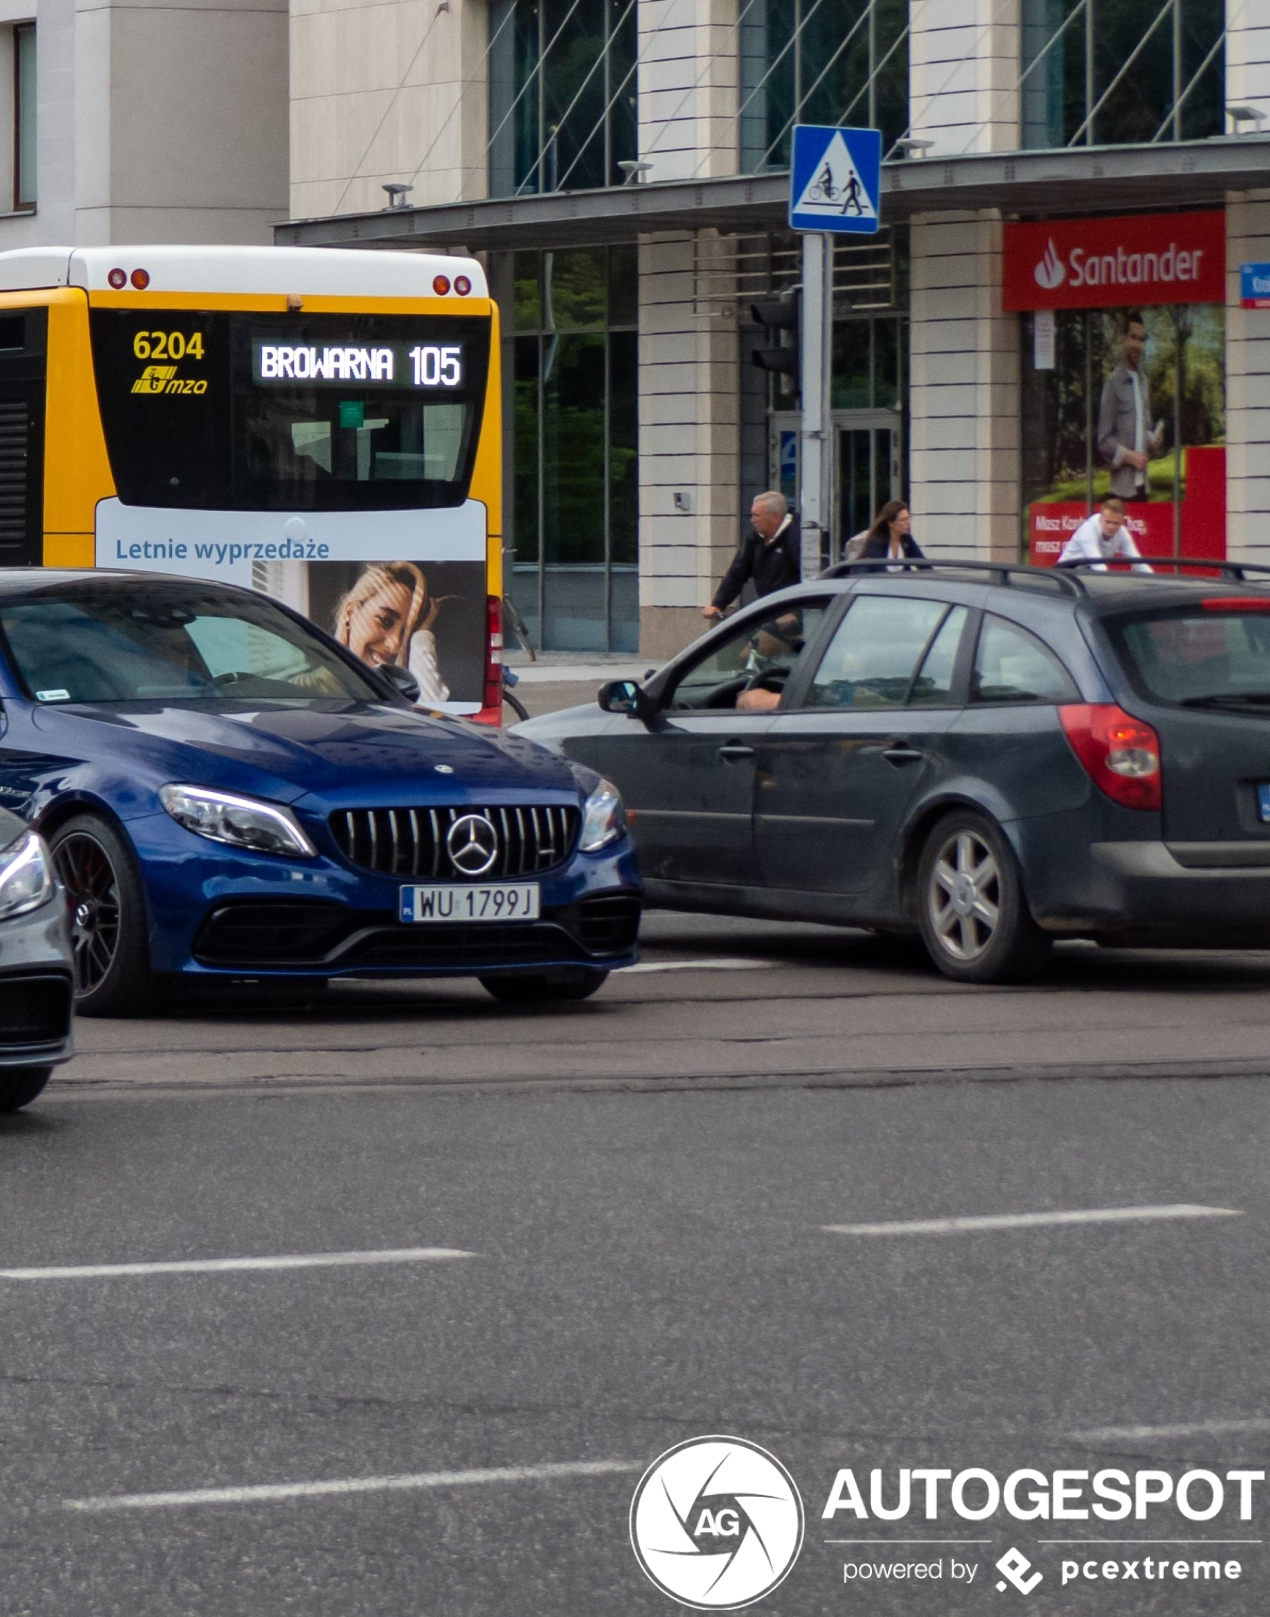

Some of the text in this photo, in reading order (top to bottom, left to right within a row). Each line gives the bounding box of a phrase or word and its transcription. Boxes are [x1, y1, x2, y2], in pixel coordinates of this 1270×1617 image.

[1069, 242, 1203, 287] Santander
[133, 331, 205, 359] 6204
[261, 346, 461, 386] BROWARNA 105
[164, 379, 208, 394] mza
[116, 538, 330, 565] Letnie wyprzedaże
[420, 889, 531, 917] WU 1799J
